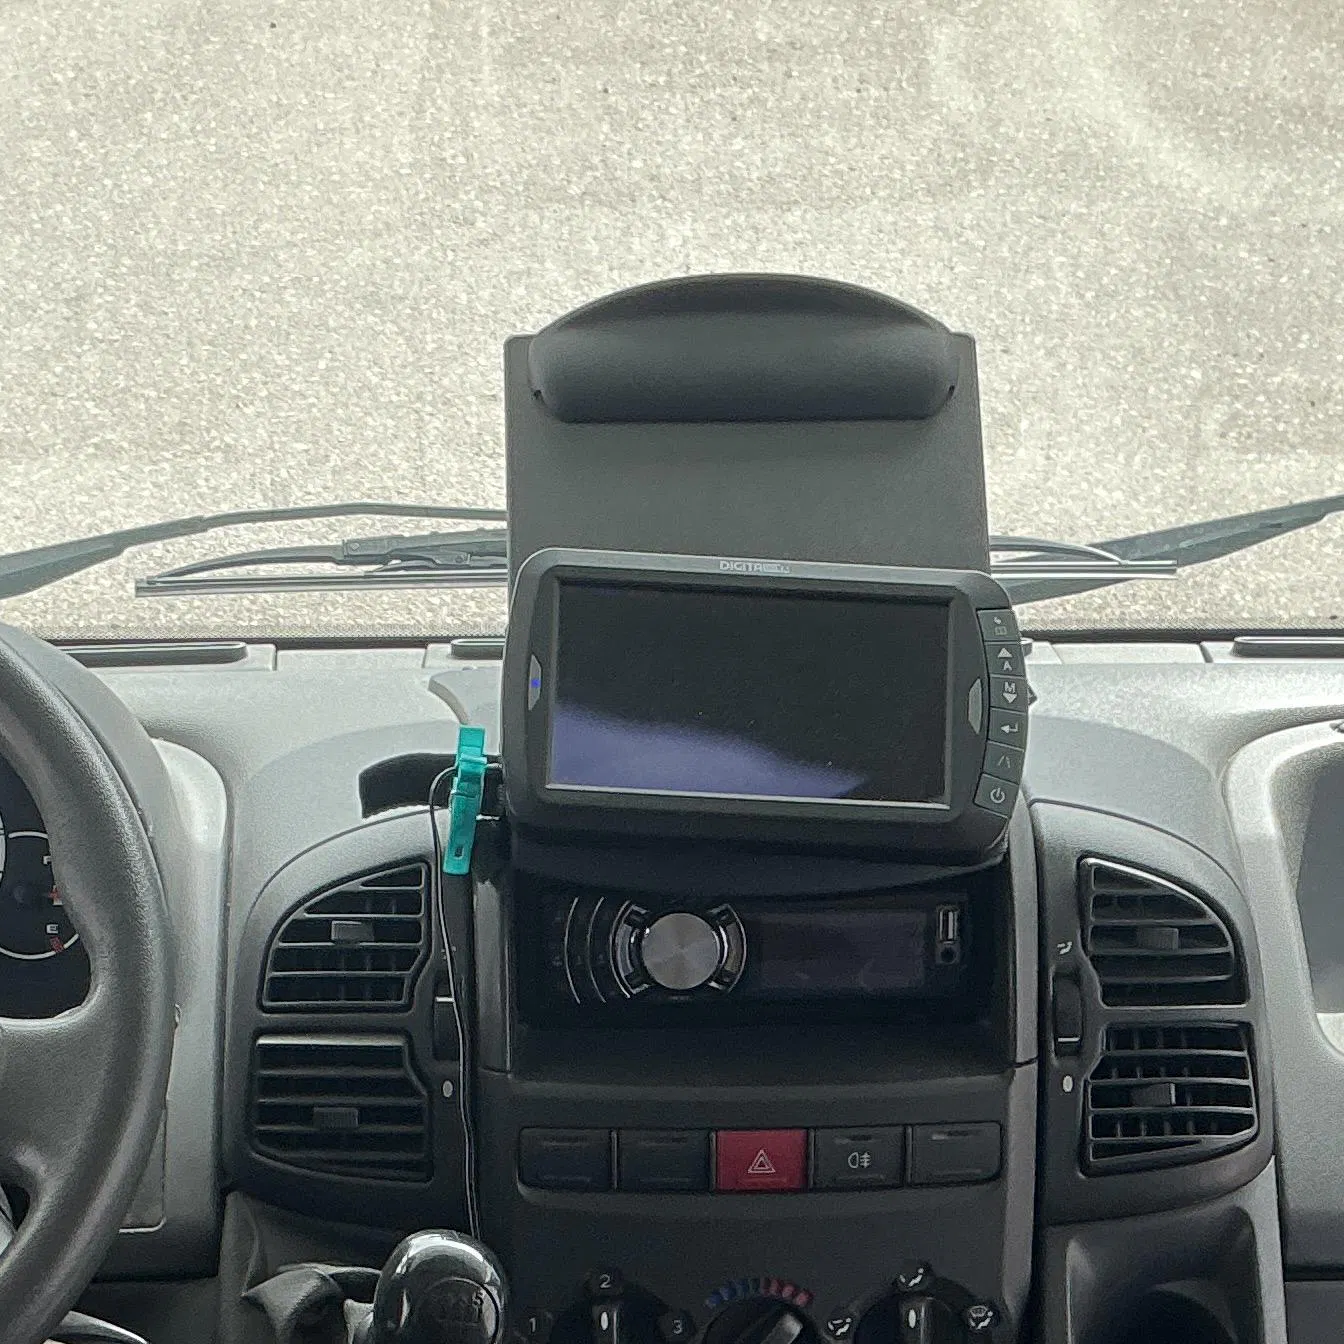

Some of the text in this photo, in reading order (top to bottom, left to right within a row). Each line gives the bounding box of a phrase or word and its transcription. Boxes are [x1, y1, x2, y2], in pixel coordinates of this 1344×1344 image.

[599, 1273, 612, 1289] 2
[528, 1317, 537, 1333] 1
[672, 1319, 684, 1335] 3
